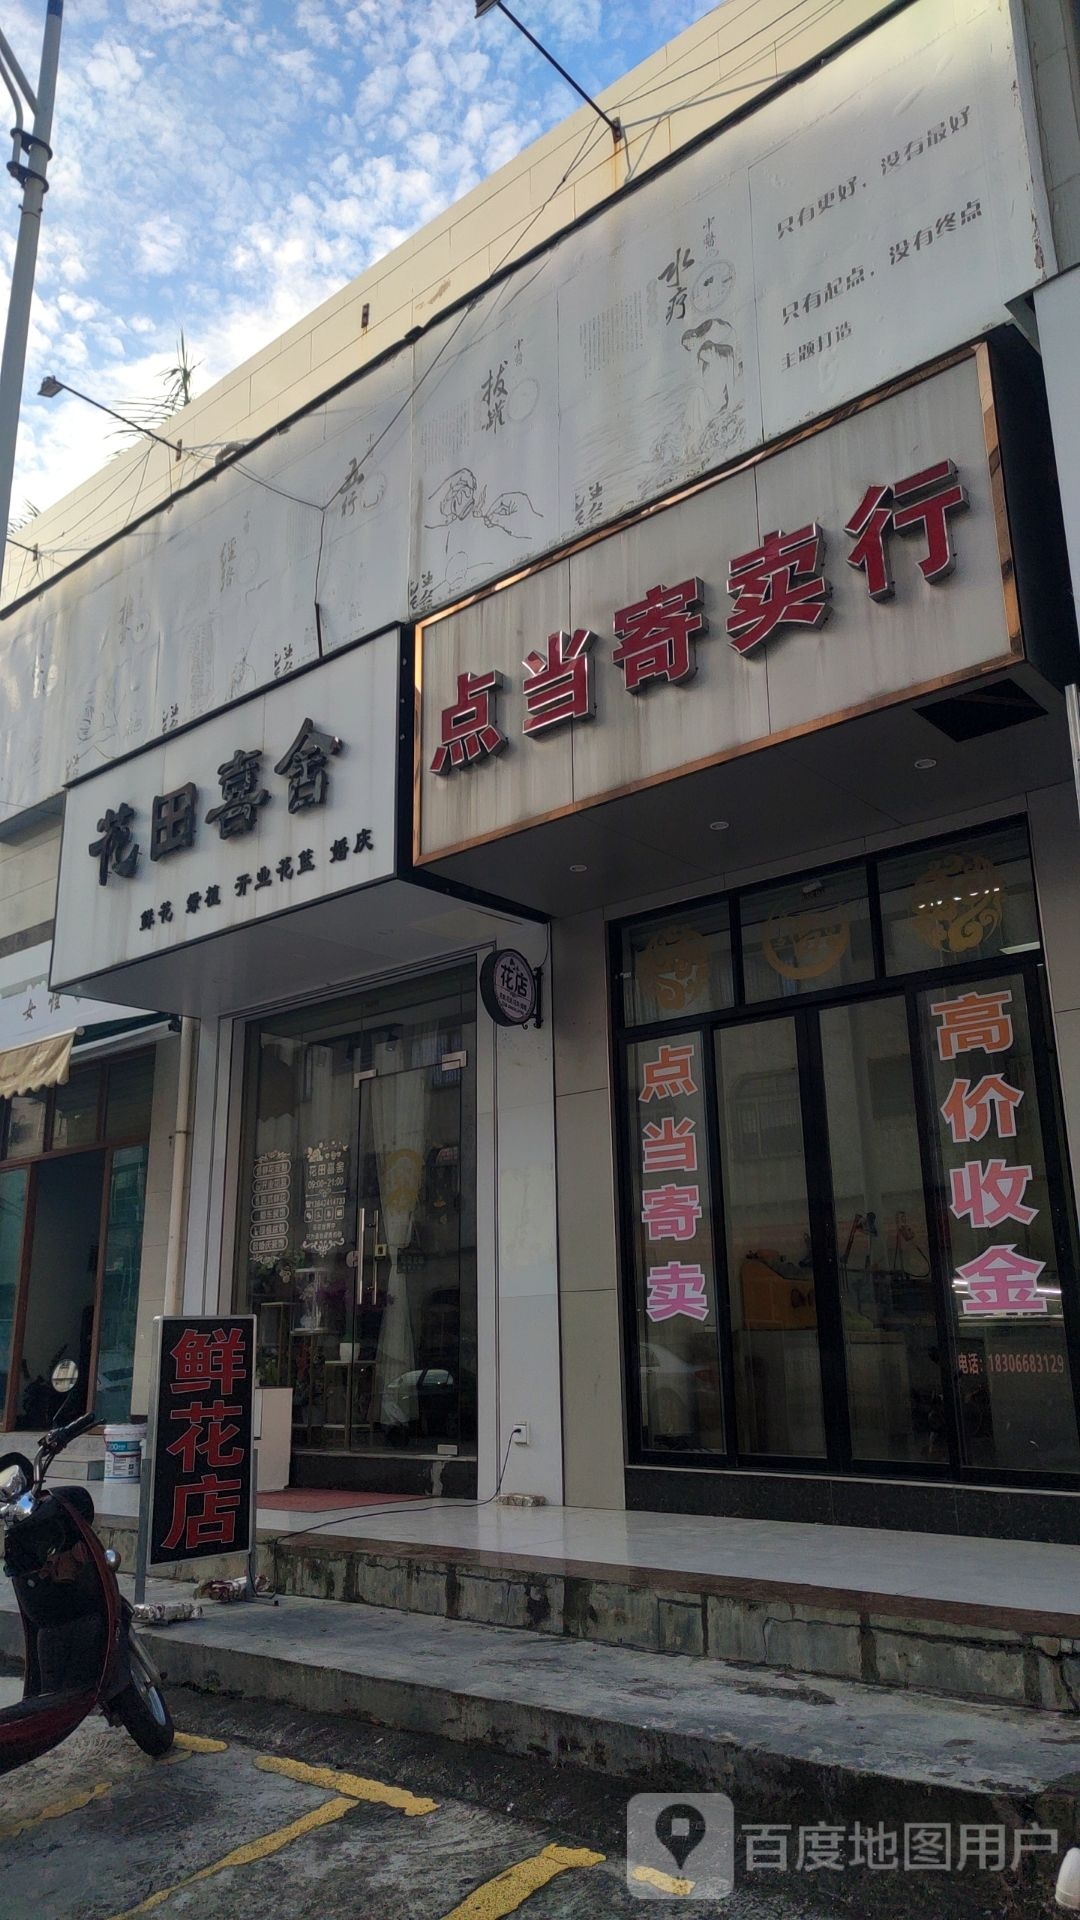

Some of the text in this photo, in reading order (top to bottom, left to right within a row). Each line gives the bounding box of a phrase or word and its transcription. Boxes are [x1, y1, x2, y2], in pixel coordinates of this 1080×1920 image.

[889, 198, 982, 265] 没有终点
[657, 248, 695, 326] 水疗
[781, 321, 852, 372] 主题打造
[429, 458, 970, 775] 点当寄卖行
[88, 717, 343, 886] 花田喜舍
[139, 901, 173, 931] 鲜花
[234, 849, 316, 897] 开业花篮
[329, 828, 374, 863] 婚庆
[500, 964, 529, 997] 花店
[638, 1044, 709, 1323] 点当寄卖
[930, 990, 1048, 1314] 高价收金
[988, 1354, 1065, 1373] 18306683129
[161, 1327, 247, 1549] 鲜花店
